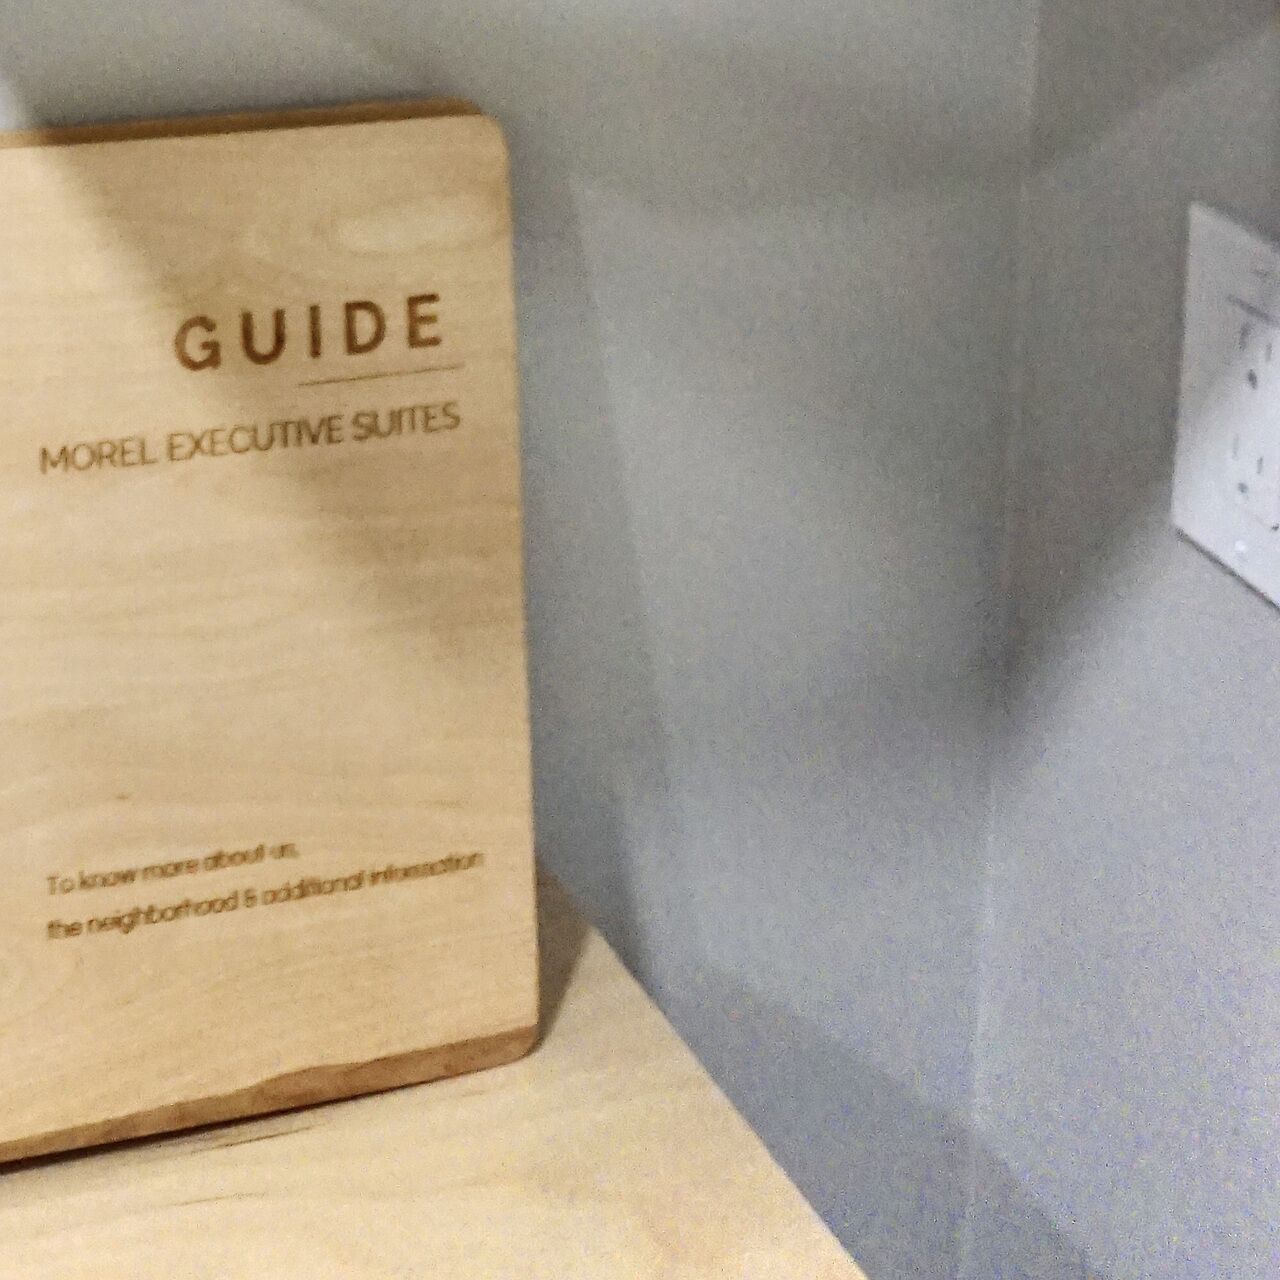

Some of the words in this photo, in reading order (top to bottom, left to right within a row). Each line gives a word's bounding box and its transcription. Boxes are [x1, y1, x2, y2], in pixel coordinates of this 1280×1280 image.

[174, 293, 443, 372] GUIDE
[39, 434, 158, 476] MOREL
[167, 415, 345, 462] EXECUTIVE
[351, 402, 462, 442] SUITES
[47, 875, 75, 896] To
[79, 869, 137, 889] know
[142, 859, 199, 881] more
[203, 842, 265, 872] about
[47, 918, 83, 938] the
[87, 891, 240, 935] neighborhood
[261, 870, 365, 905] additional
[367, 852, 486, 886] information
